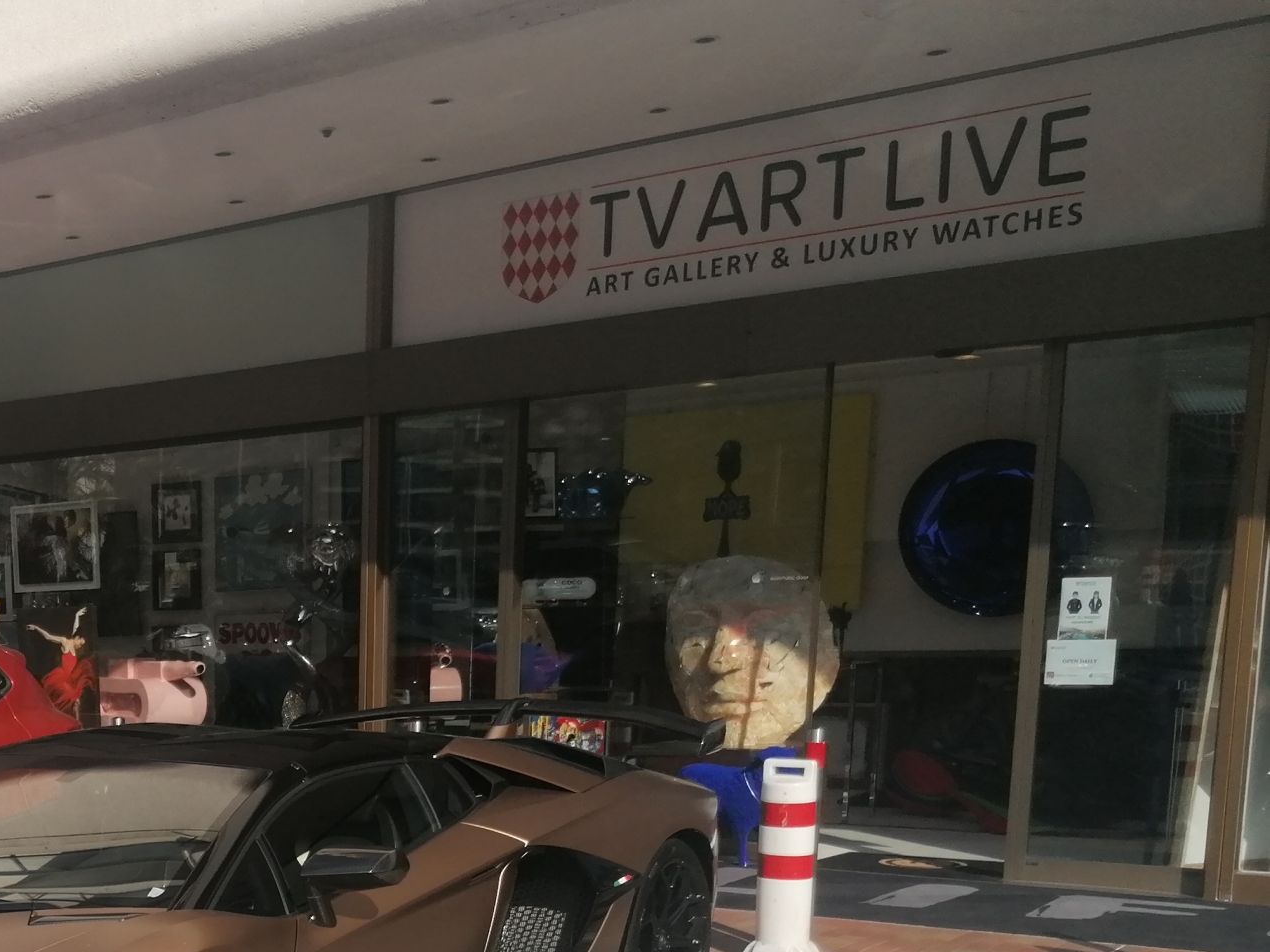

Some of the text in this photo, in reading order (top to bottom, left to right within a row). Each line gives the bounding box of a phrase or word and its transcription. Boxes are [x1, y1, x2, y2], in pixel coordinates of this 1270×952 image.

[586, 201, 1085, 298] ART GALLERY & LUXURY WATCHES
